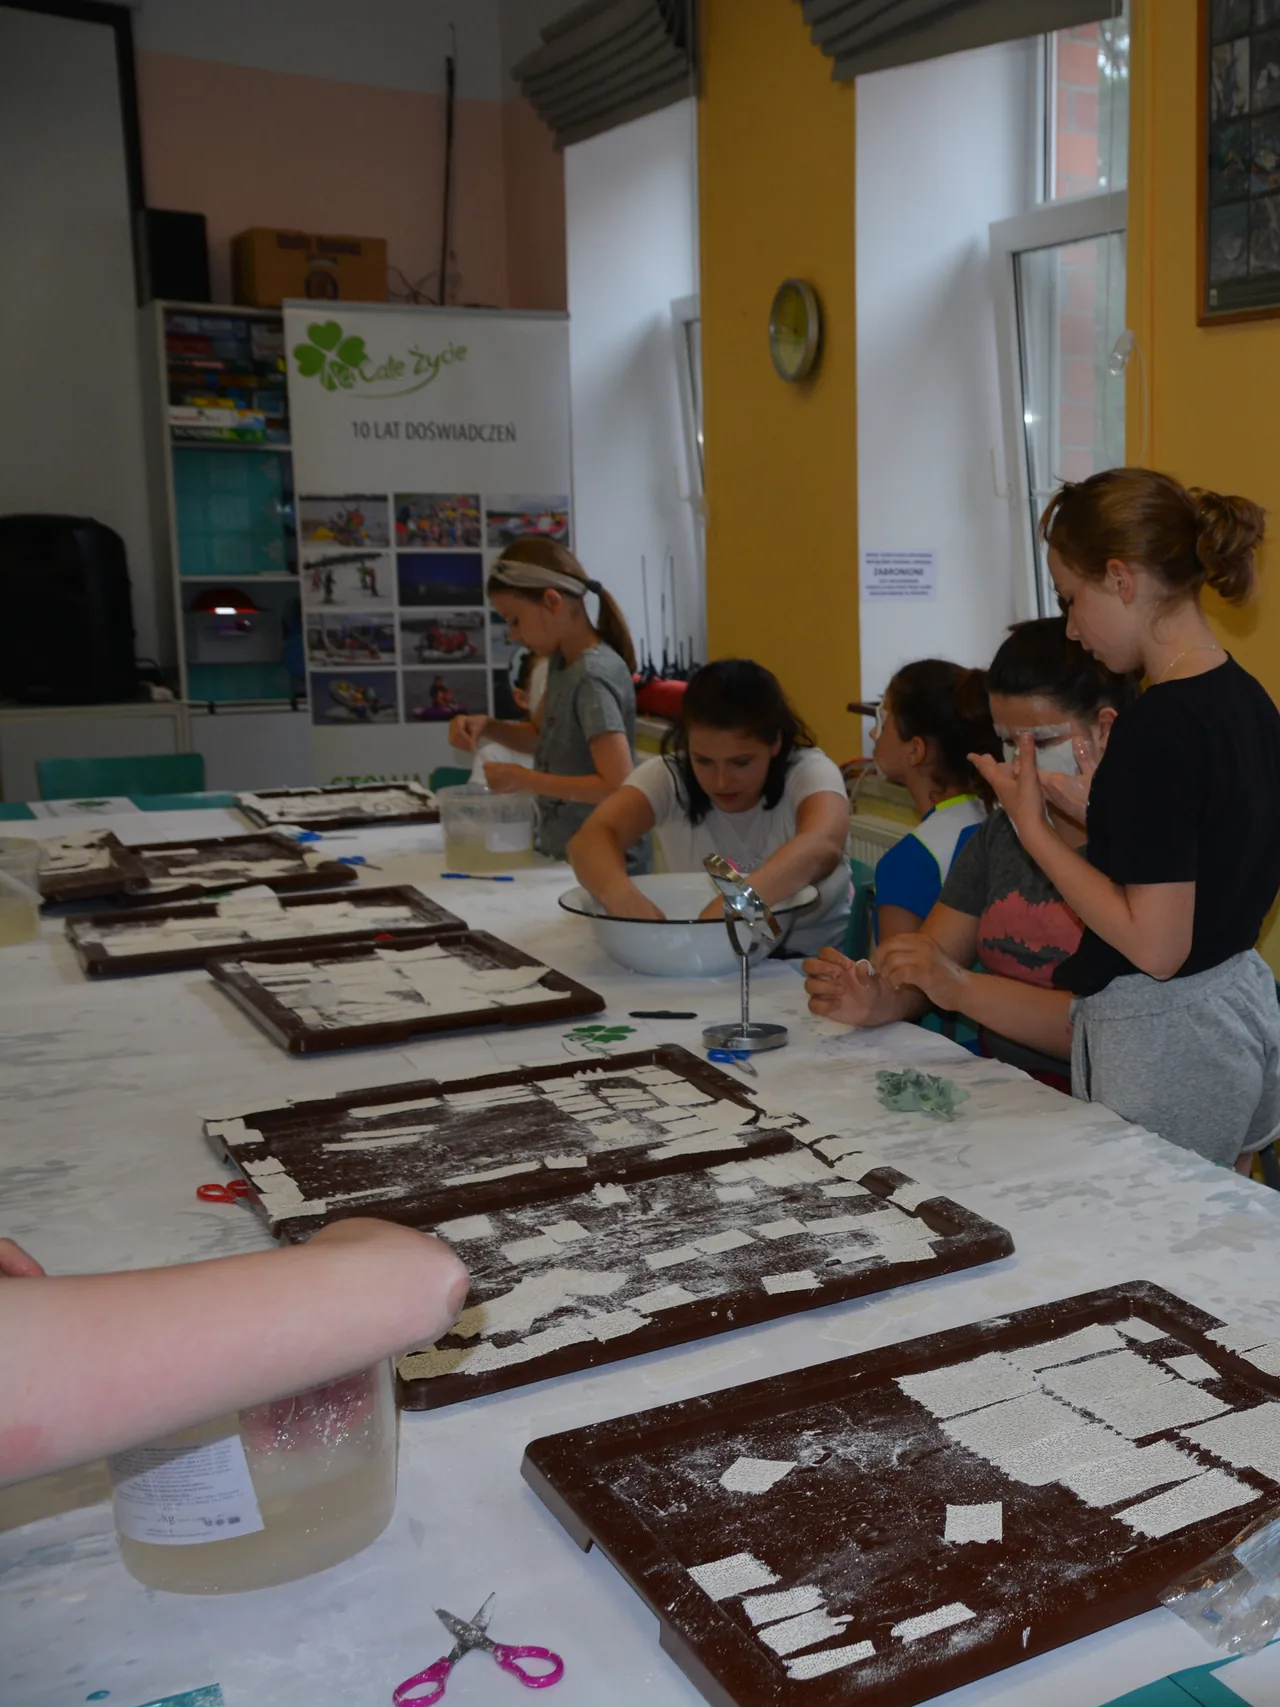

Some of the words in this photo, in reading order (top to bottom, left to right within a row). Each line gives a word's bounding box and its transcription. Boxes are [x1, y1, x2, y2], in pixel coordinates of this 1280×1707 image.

[352, 421, 370, 439] 10
[374, 421, 401, 440] LAT
[405, 419, 517, 443] DOŚWIADCZEŃ
